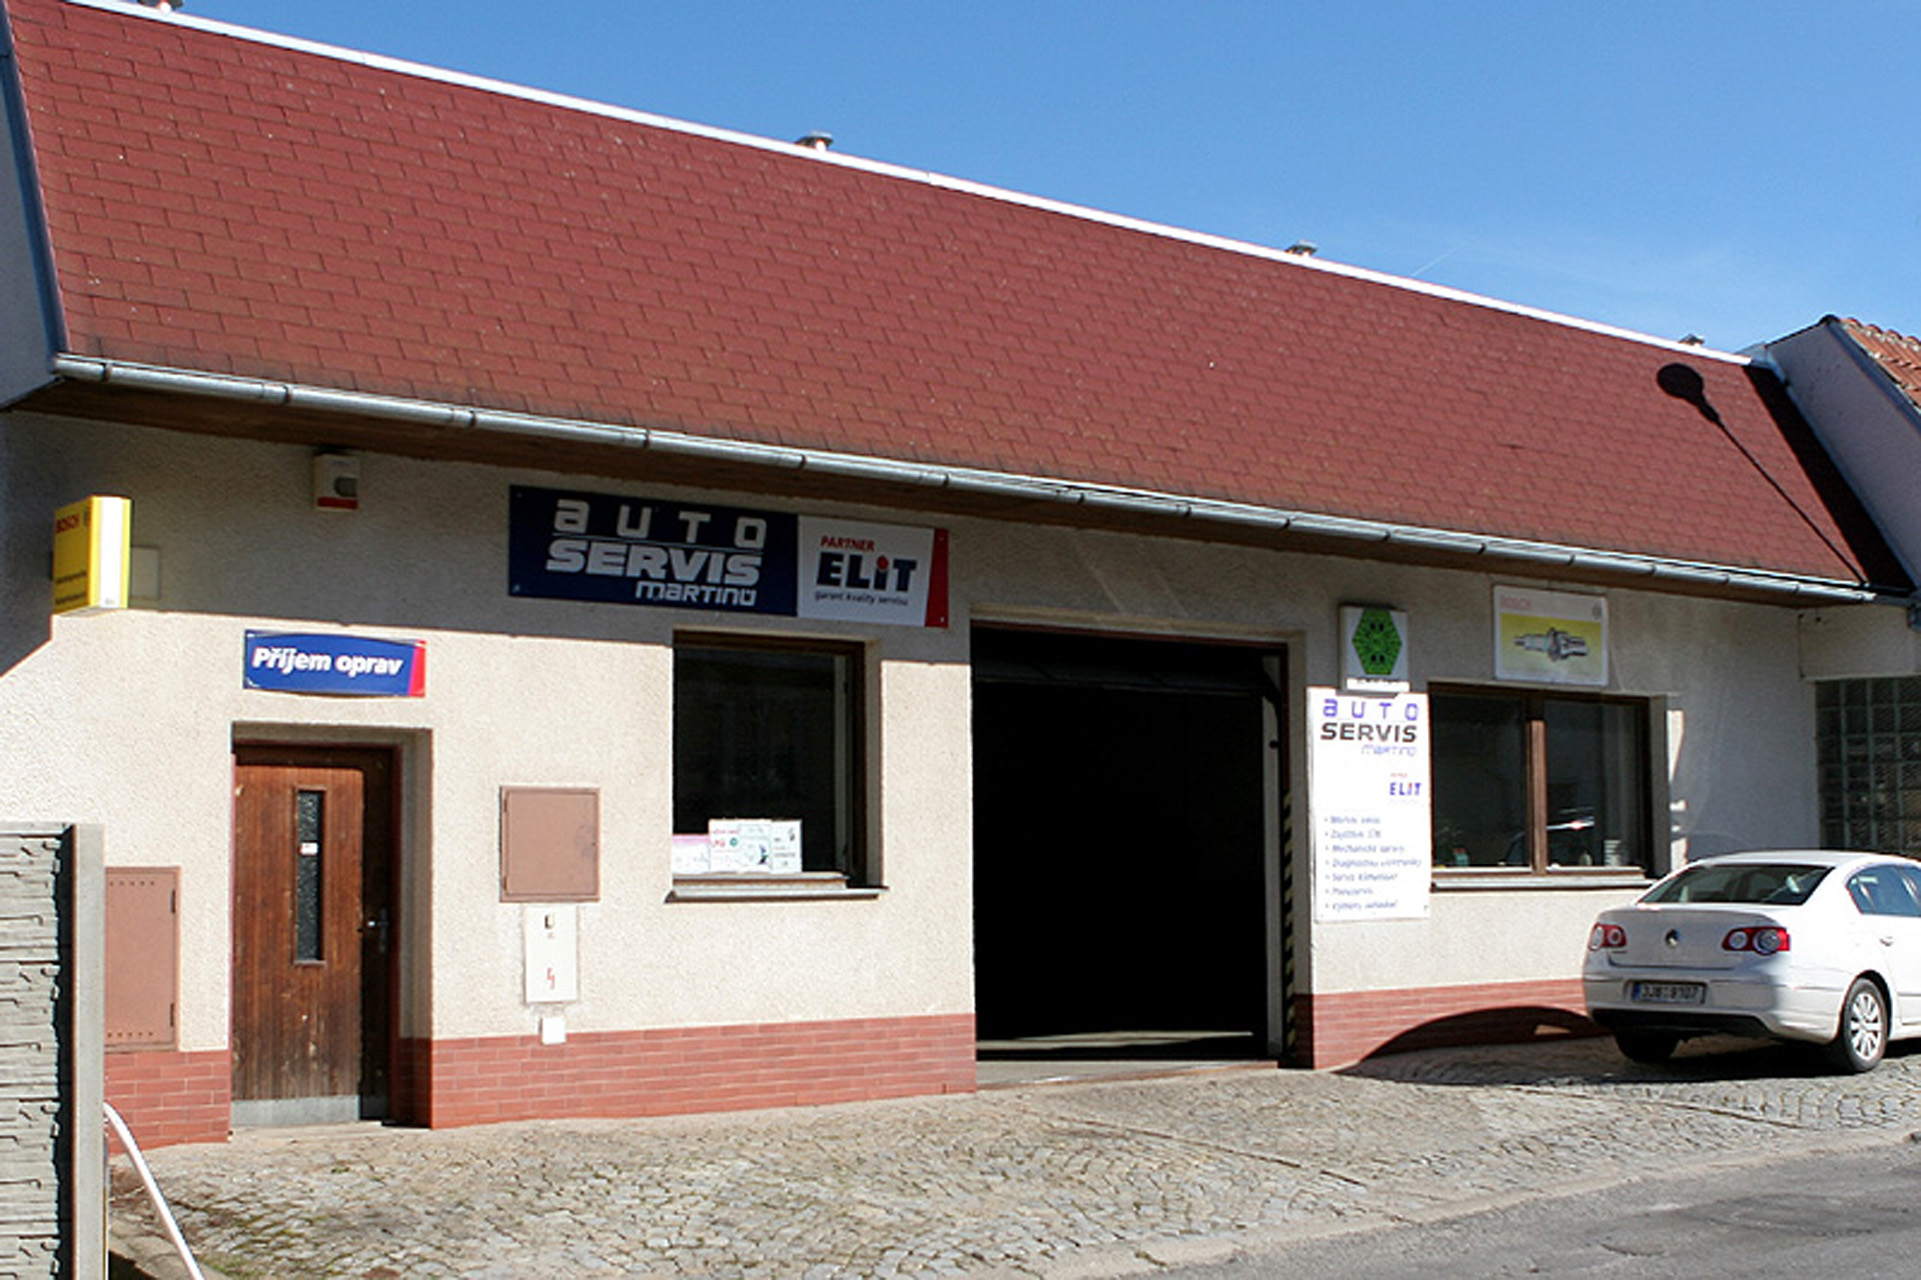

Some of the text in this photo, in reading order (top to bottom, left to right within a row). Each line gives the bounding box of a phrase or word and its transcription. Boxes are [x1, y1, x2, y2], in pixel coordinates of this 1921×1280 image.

[820, 535, 875, 552] PARTNER
[546, 538, 763, 587] SERVIS
[252, 647, 404, 677] Příjem oprav
[1321, 722, 1418, 743] SERVIS
